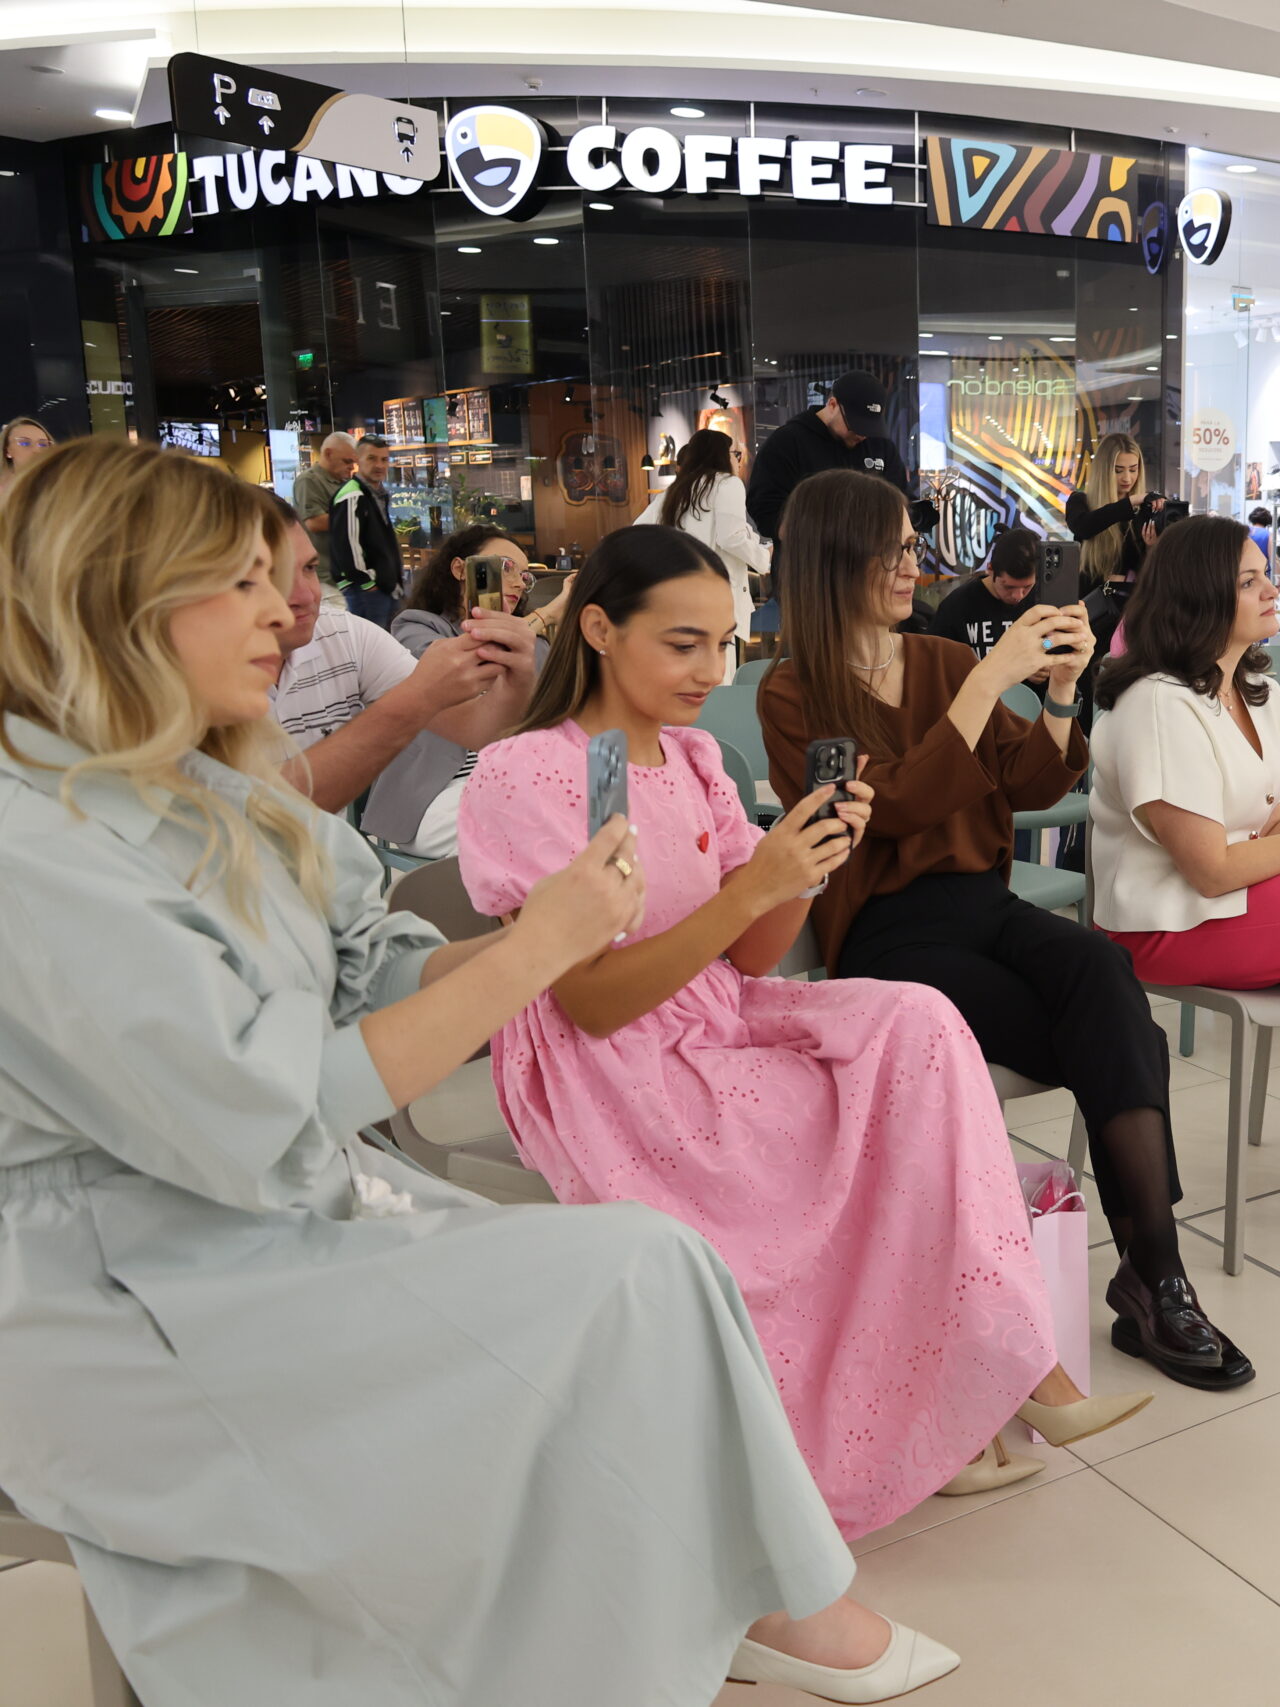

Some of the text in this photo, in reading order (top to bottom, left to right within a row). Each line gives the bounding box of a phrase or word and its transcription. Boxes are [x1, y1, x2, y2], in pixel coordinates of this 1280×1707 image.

[213, 73, 237, 104] P
[567, 125, 894, 205] COFFEE
[1192, 427, 1230, 446] 50%
[966, 620, 994, 645] WE
